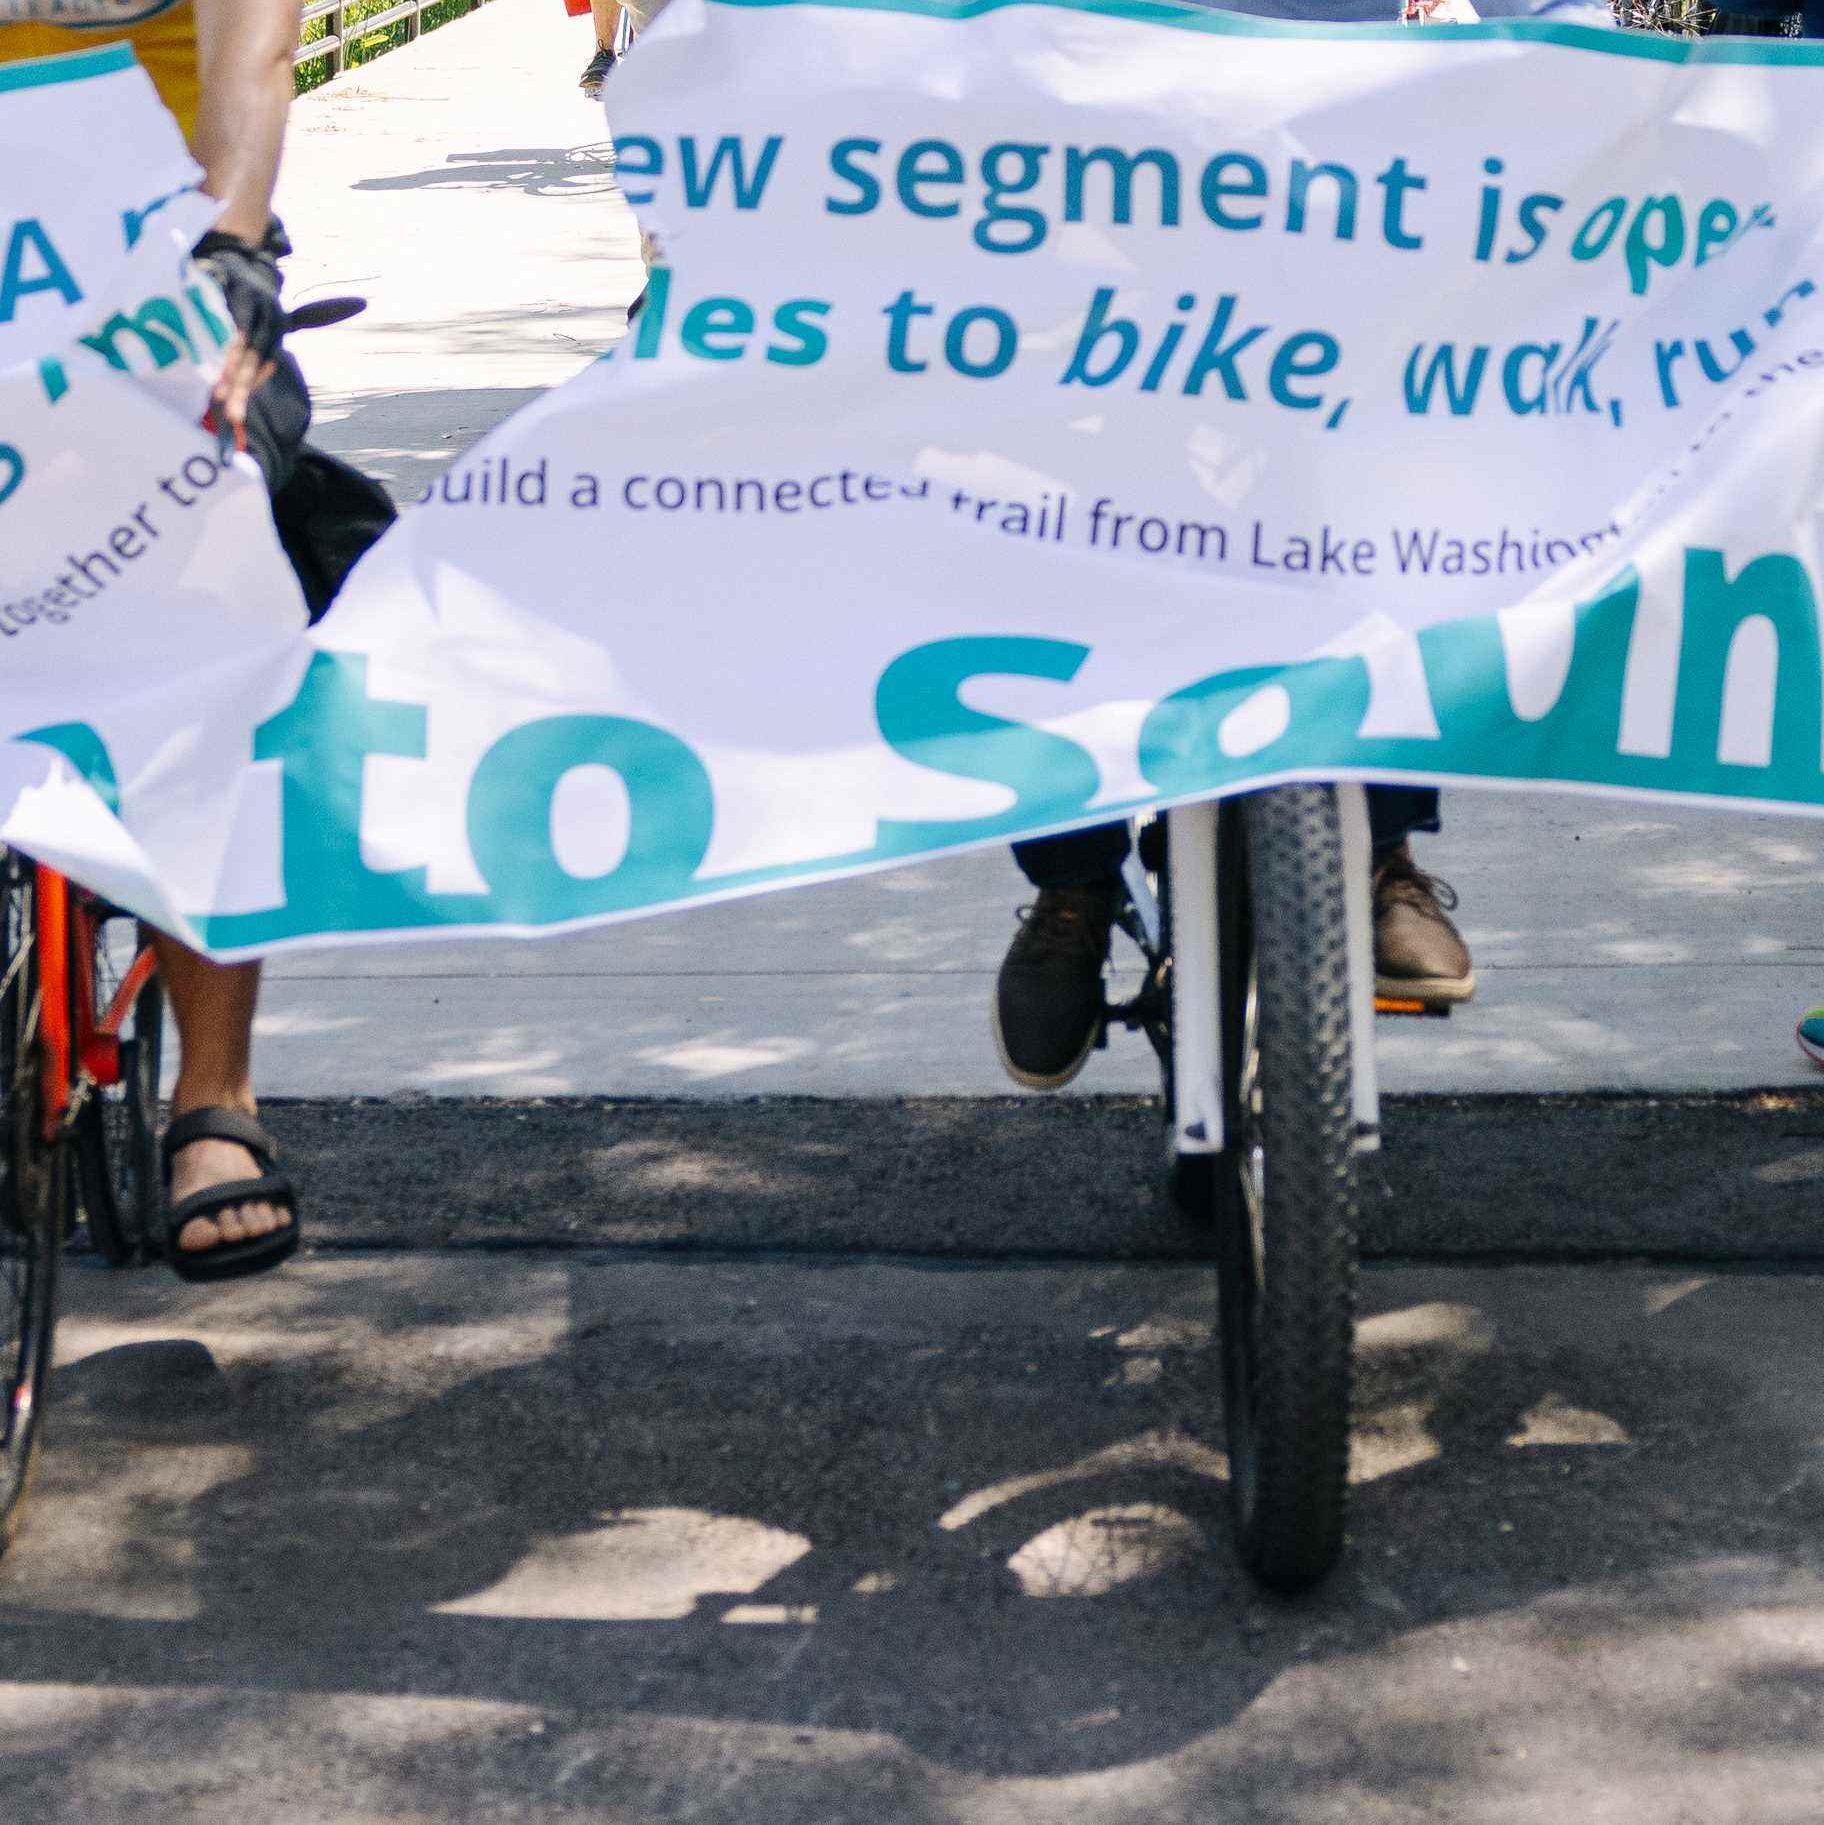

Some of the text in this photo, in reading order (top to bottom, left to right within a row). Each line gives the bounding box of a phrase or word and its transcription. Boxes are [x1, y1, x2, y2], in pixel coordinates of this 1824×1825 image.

[824, 132, 1429, 254] segment
[1475, 156, 1567, 264] is
[885, 286, 1018, 380] to
[1059, 285, 1352, 431] bike,
[1401, 316, 1626, 427] walk,
[571, 472, 598, 508] a
[951, 489, 1066, 541] trail
[1088, 498, 1229, 562] from
[1250, 519, 1378, 577] Lake
[252, 649, 715, 921] to
